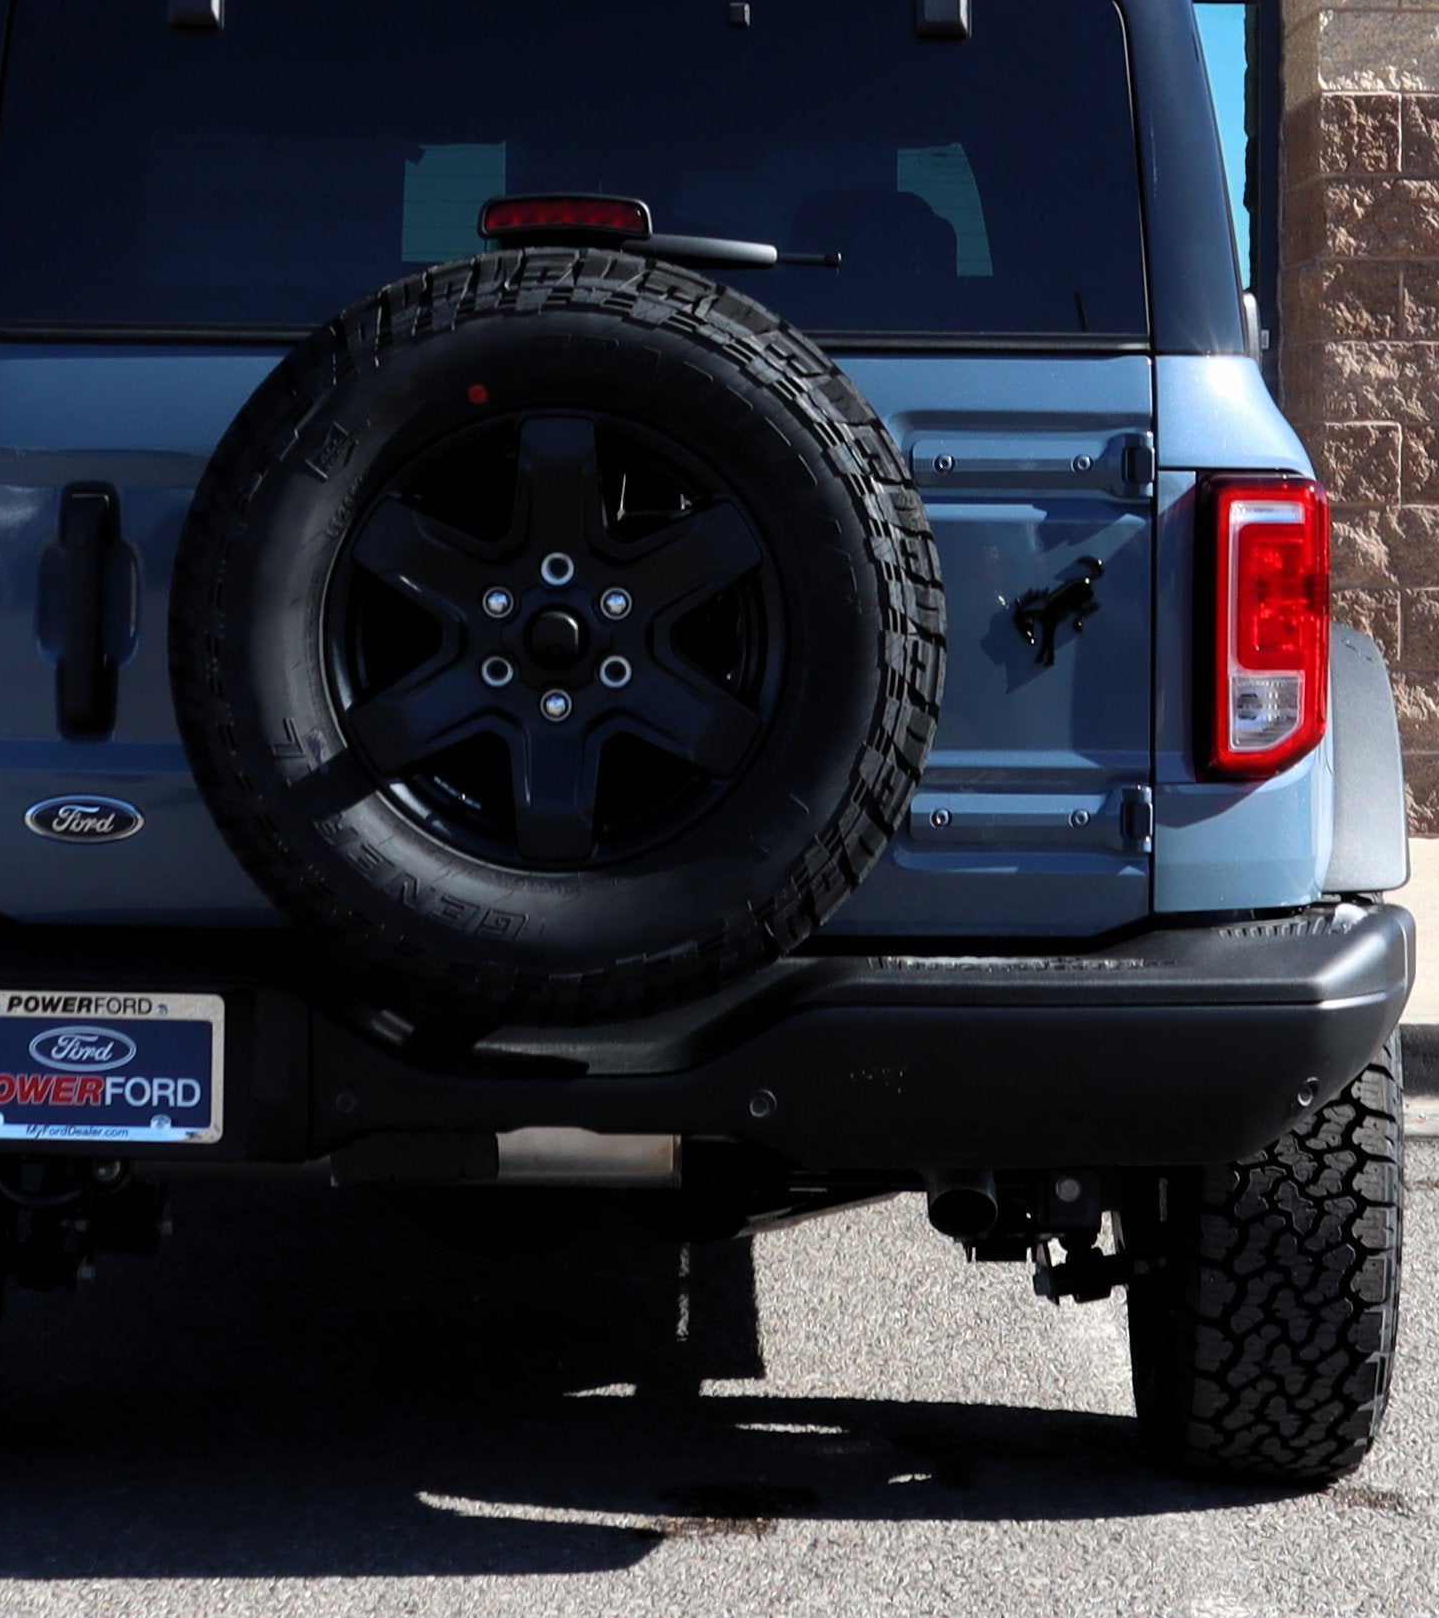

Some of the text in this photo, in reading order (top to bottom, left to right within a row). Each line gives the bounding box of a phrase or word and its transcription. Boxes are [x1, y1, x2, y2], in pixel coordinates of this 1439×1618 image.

[52, 804, 116, 833] Ford
[7, 995, 153, 1014] POWERFORD
[50, 1034, 114, 1062] Ford
